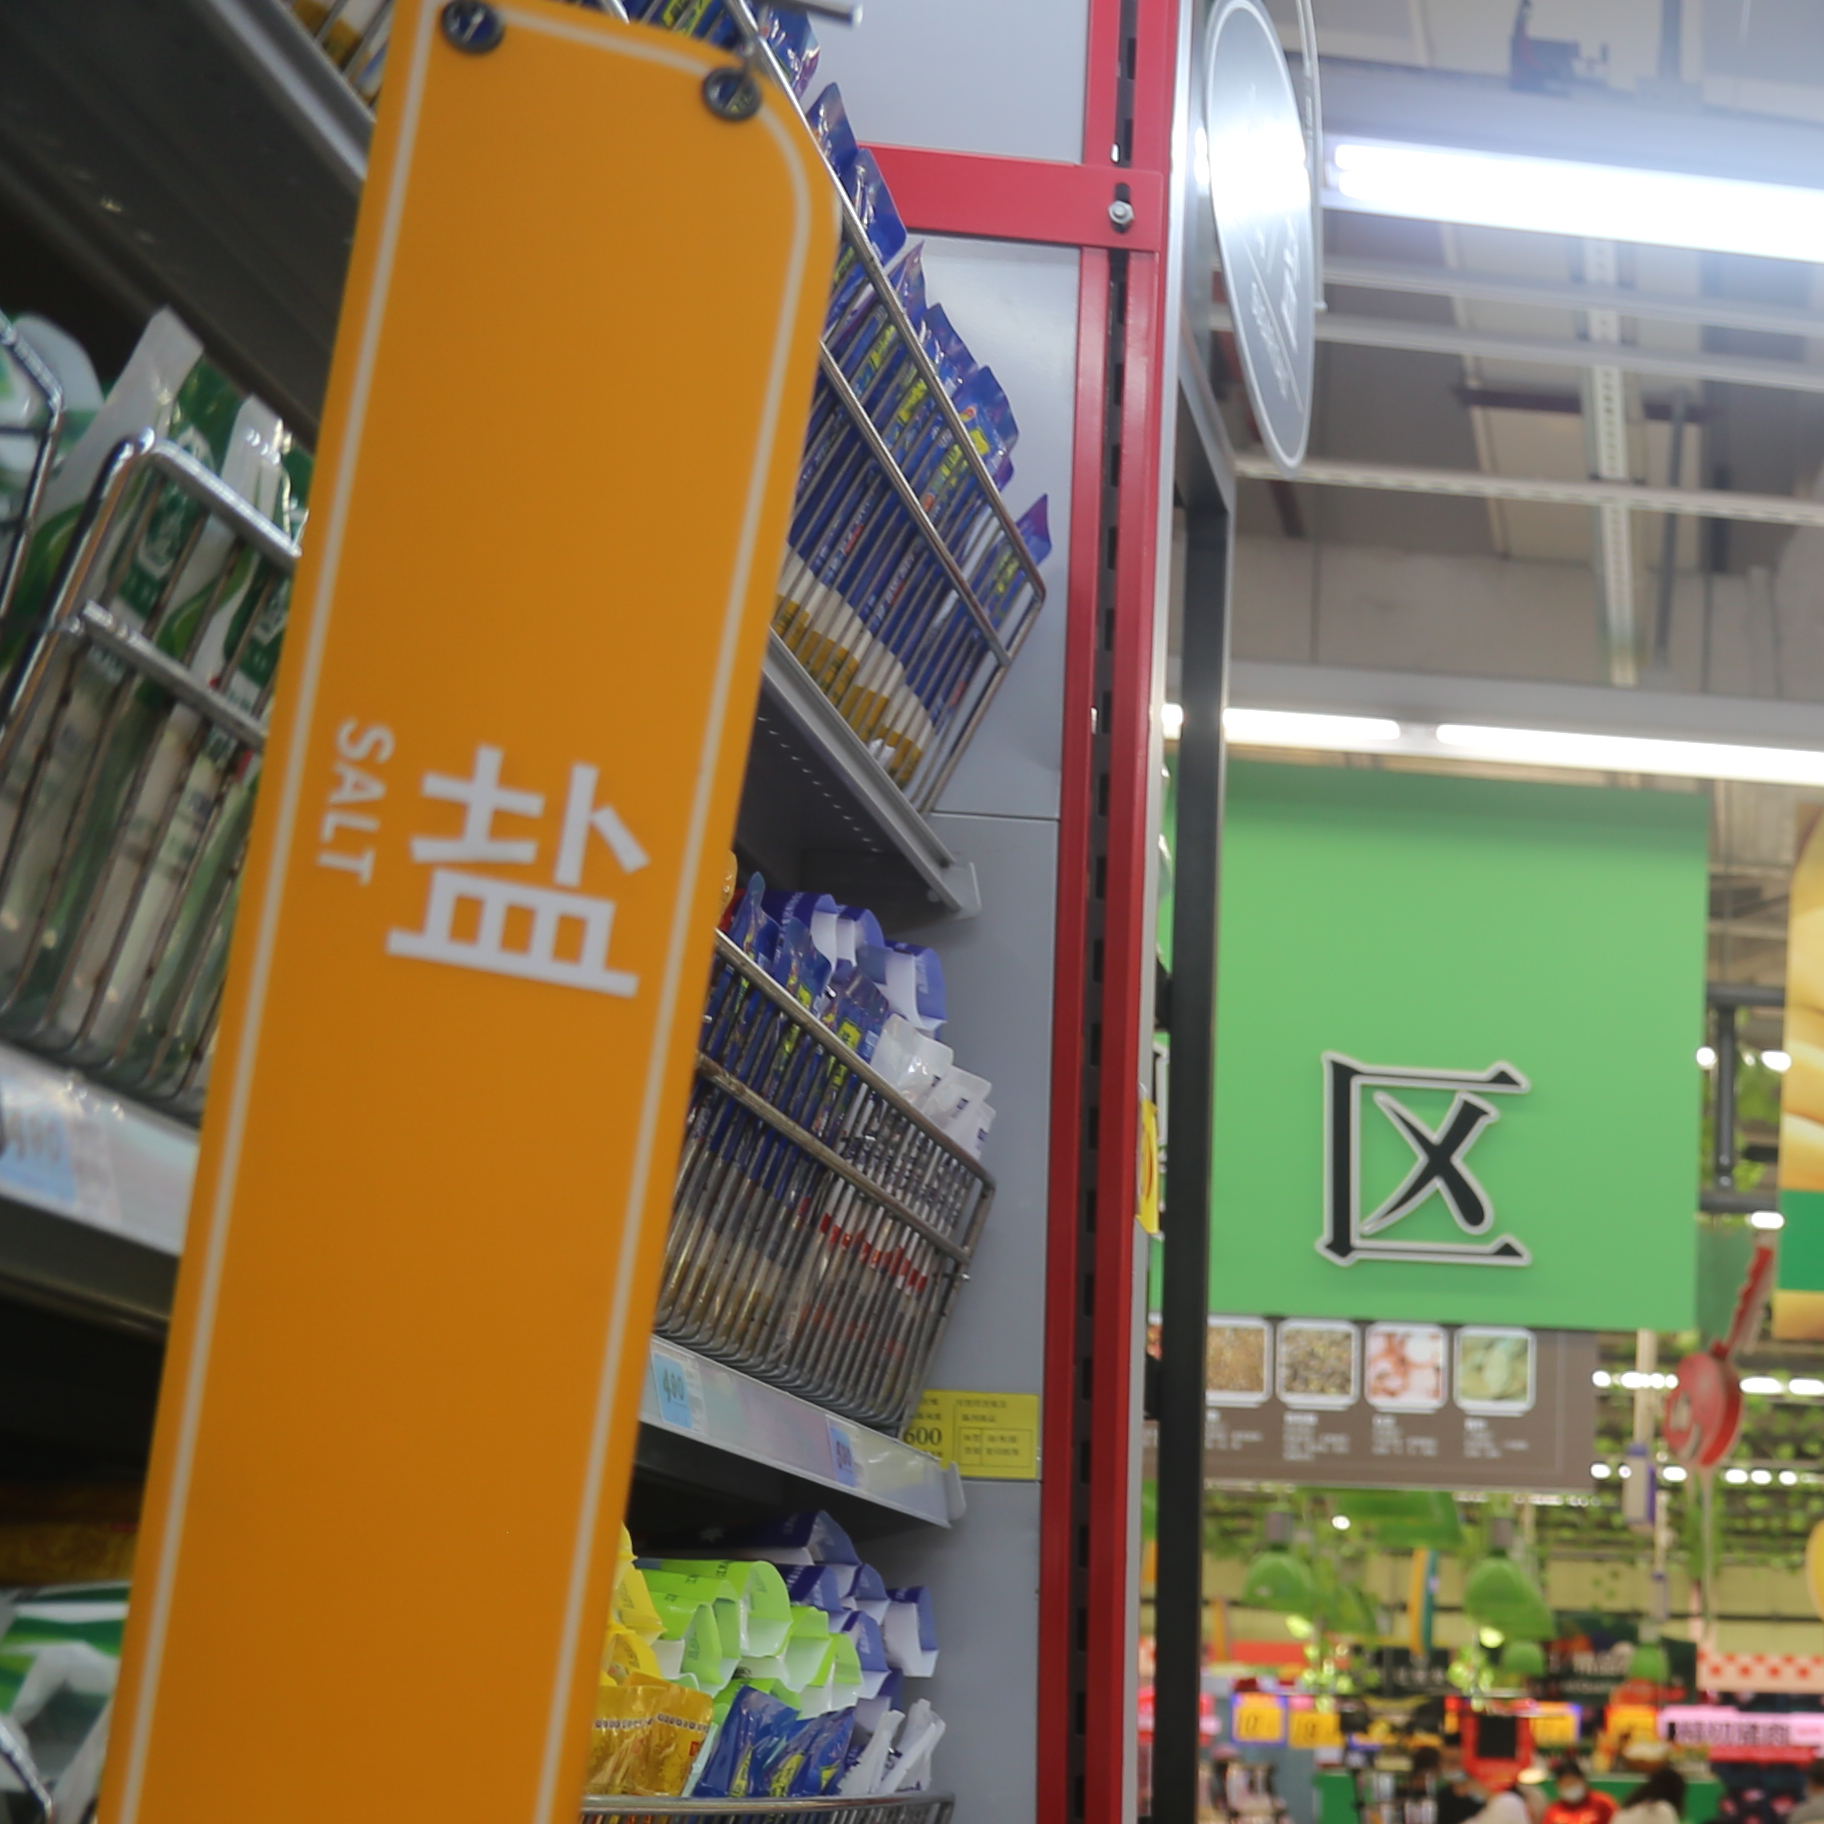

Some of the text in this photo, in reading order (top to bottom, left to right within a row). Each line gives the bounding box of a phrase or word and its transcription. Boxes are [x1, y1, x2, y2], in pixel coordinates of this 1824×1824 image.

[314, 715, 397, 887] SALT
[385, 746, 651, 999] 盐
[1315, 1049, 1533, 1267] 区
